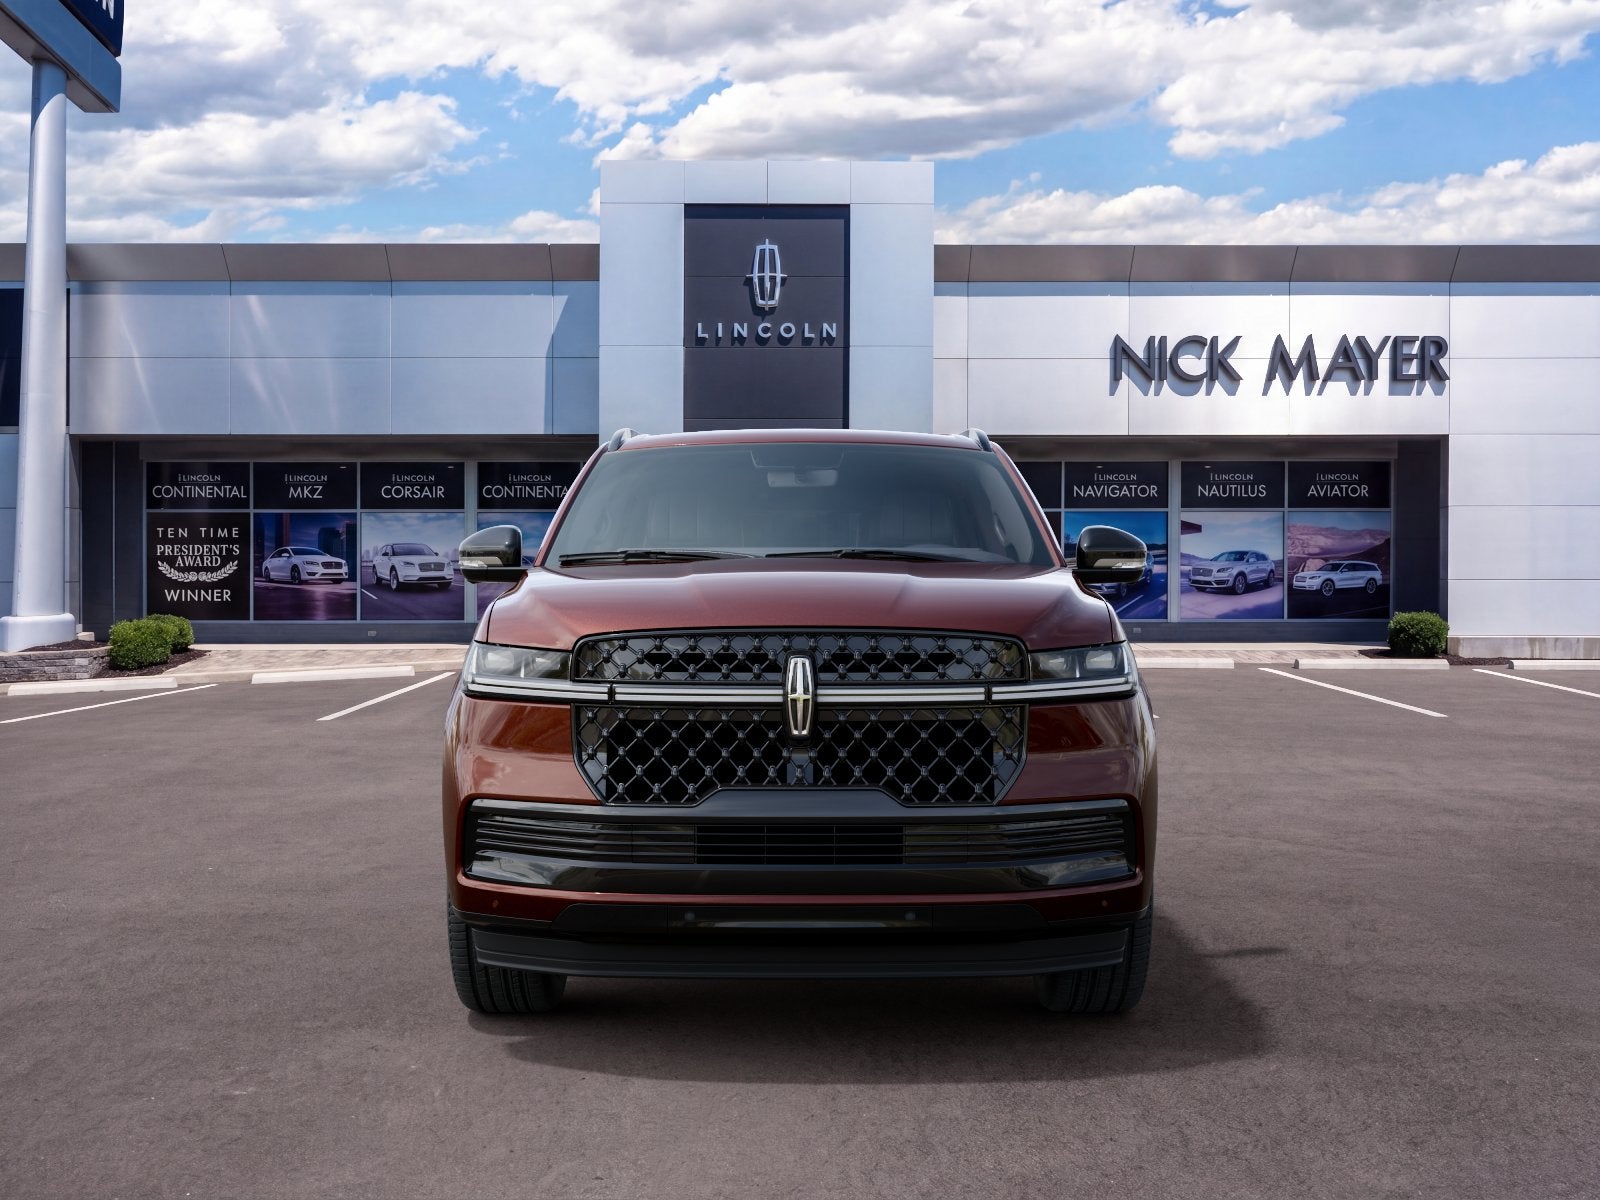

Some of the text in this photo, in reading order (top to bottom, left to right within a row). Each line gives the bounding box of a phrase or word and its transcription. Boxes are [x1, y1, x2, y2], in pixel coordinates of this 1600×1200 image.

[697, 322, 837, 339] LINCOLN
[1111, 333, 1450, 382] NICK MAYER
[182, 474, 221, 482] LINCOLN
[289, 474, 328, 482] LINCOLN
[396, 474, 435, 482] LINCOLN
[512, 474, 551, 482] LINCOLN
[1098, 473, 1137, 481] LINCOLN
[1214, 473, 1253, 481] LINCOLN
[1320, 473, 1359, 481] LINCOLN
[152, 485, 247, 499] CONTINENTAL
[288, 486, 323, 499] MKZ
[381, 485, 445, 499] CORSAIR
[482, 485, 568, 499] CONTINENTA
[1073, 485, 1158, 498] NAVIGATOR
[1198, 484, 1267, 498] NAUTILUS
[1307, 484, 1369, 498] AVIATOR
[157, 527, 240, 538] TEN TIME
[156, 544, 240, 556] PRESIDENT'S
[175, 555, 221, 567] AWARD
[164, 589, 231, 602] WINNER
